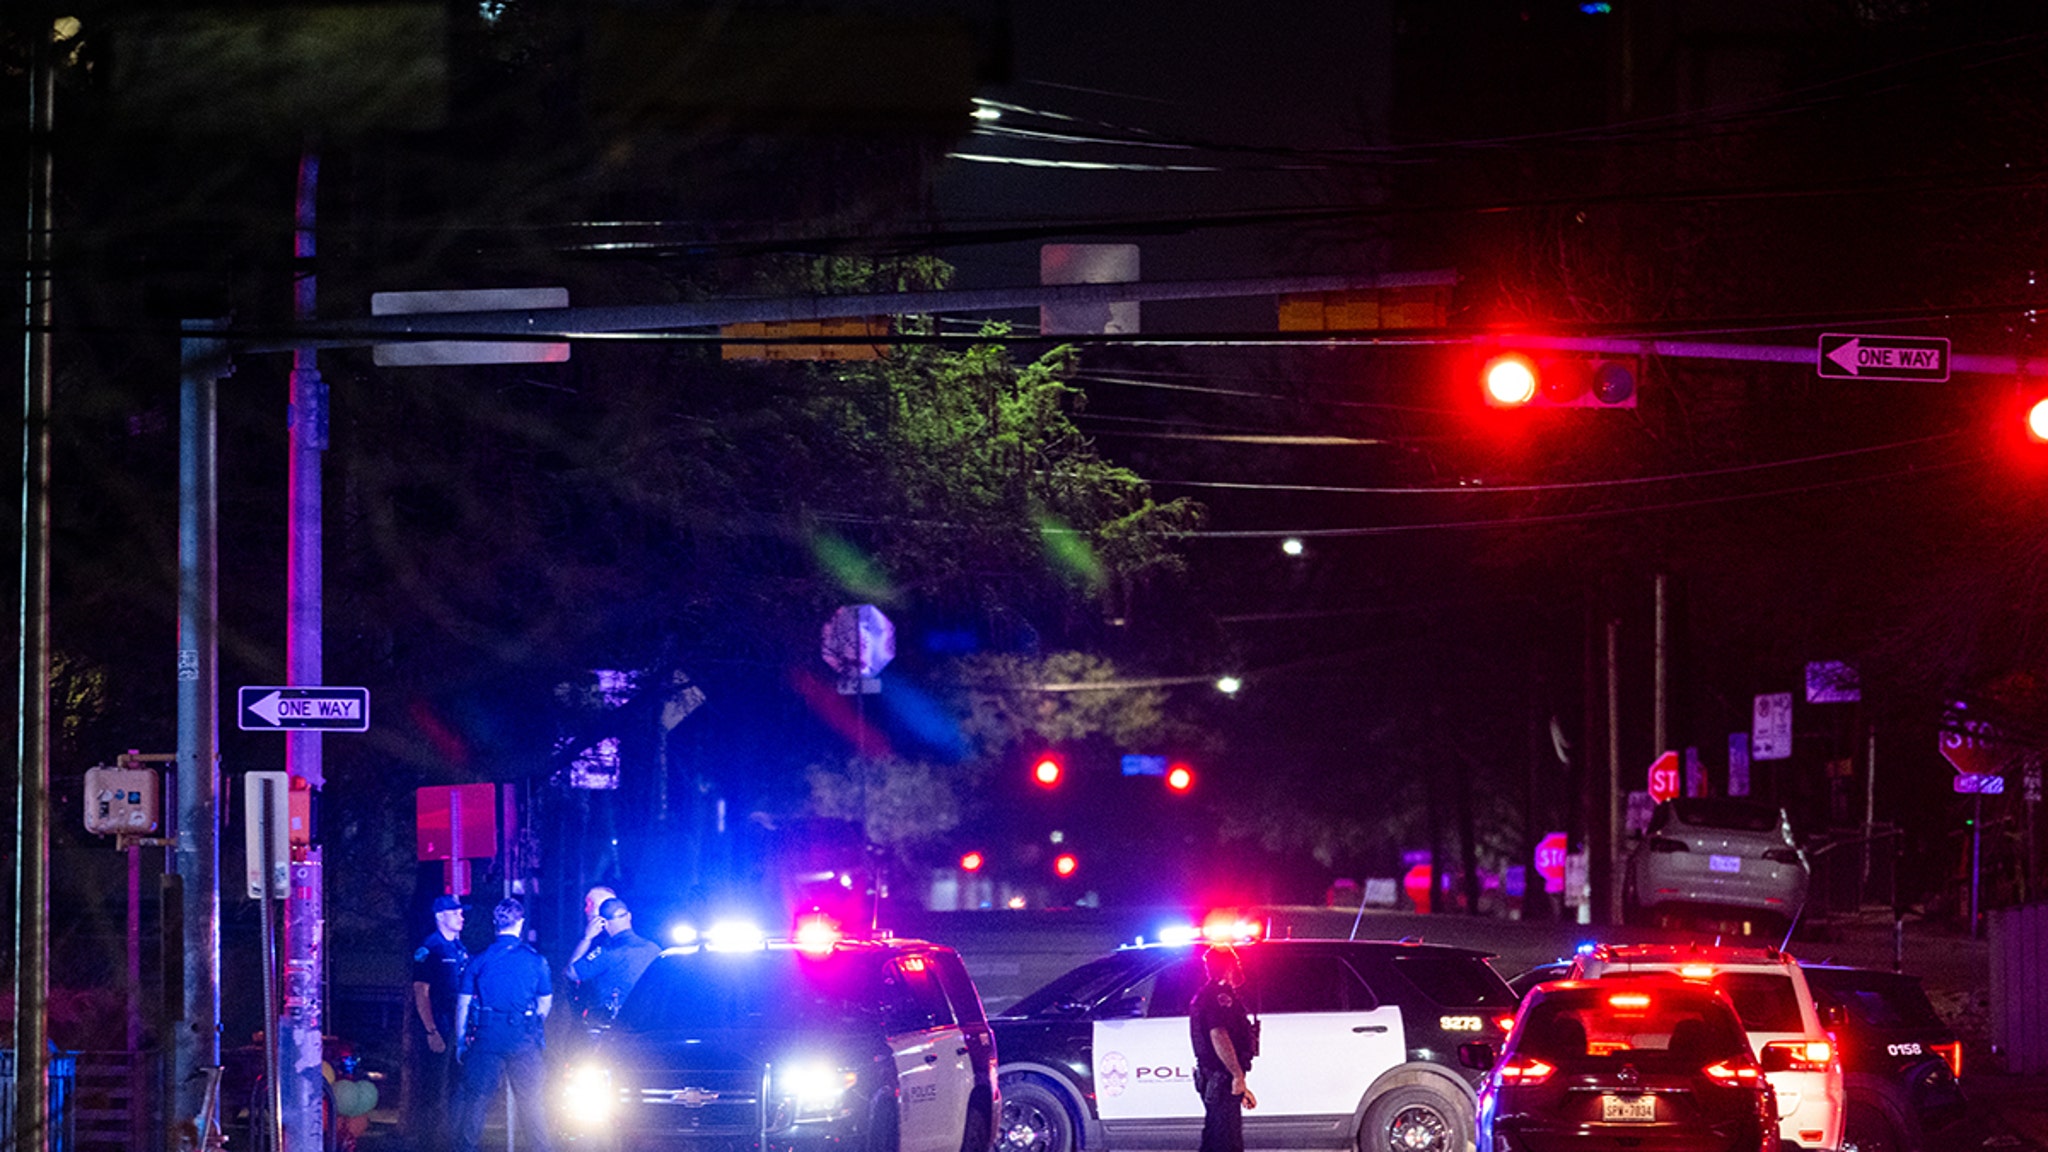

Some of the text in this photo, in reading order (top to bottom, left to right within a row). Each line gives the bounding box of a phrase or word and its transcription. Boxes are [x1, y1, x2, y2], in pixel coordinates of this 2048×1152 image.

[1857, 348, 1935, 367] ONE WAY
[278, 701, 352, 716] ONE WAY
[1944, 720, 1994, 749] STO
[1654, 770, 1676, 792] ST
[1887, 1043, 1922, 1056] 0158
[1136, 1066, 1195, 1078] POL
[911, 1083, 936, 1098] POLICE
